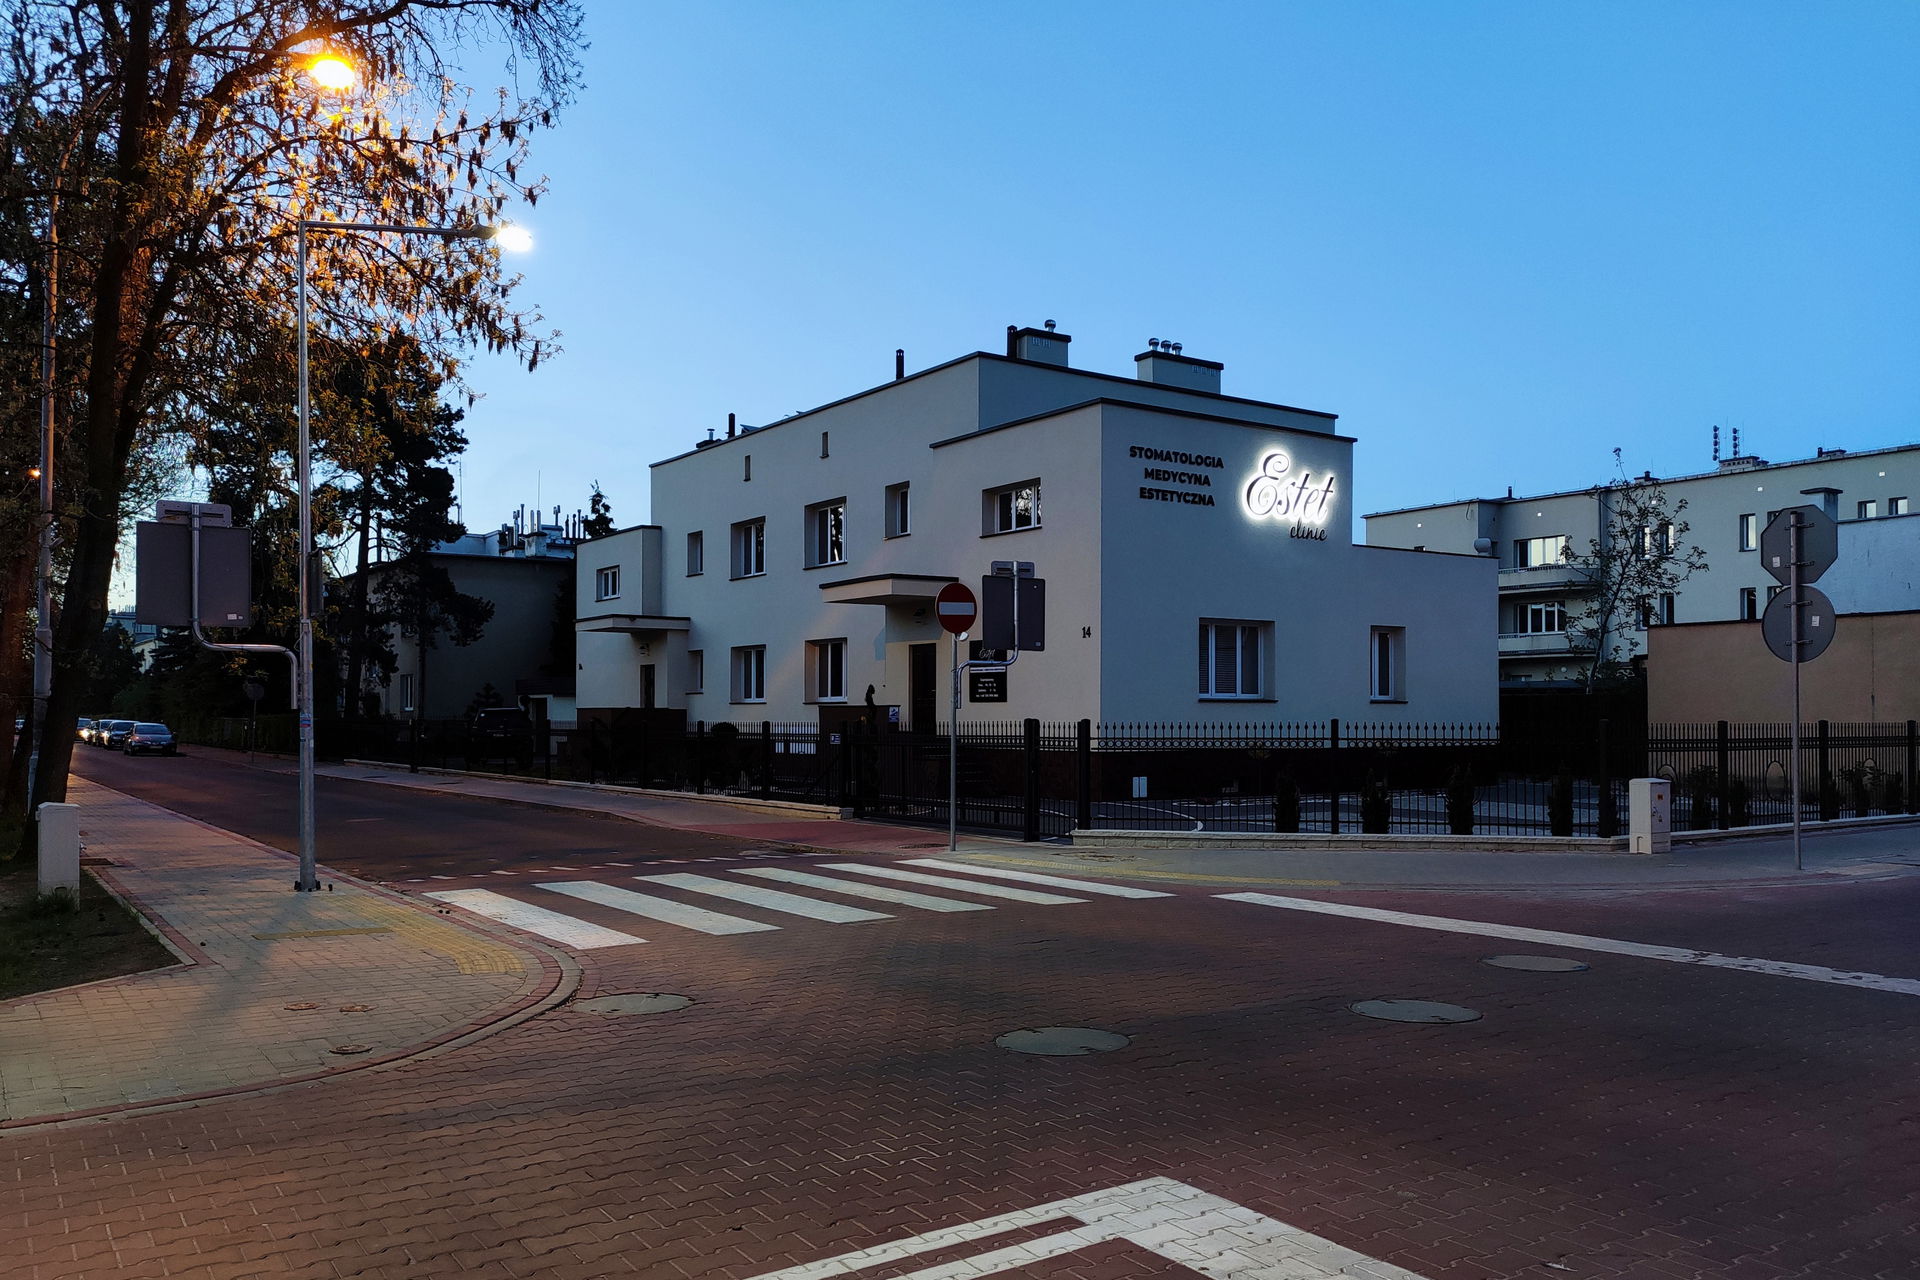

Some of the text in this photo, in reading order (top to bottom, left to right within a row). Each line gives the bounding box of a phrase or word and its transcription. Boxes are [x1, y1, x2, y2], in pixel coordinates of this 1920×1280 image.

[1129, 445, 1224, 469] STOMATOLOGIA
[1144, 467, 1211, 487] MEDYCYNA
[1246, 453, 1334, 519] Estet
[1139, 486, 1215, 506] ESTETYCZNA
[1290, 519, 1328, 541] clinic
[1082, 626, 1092, 639] 14
